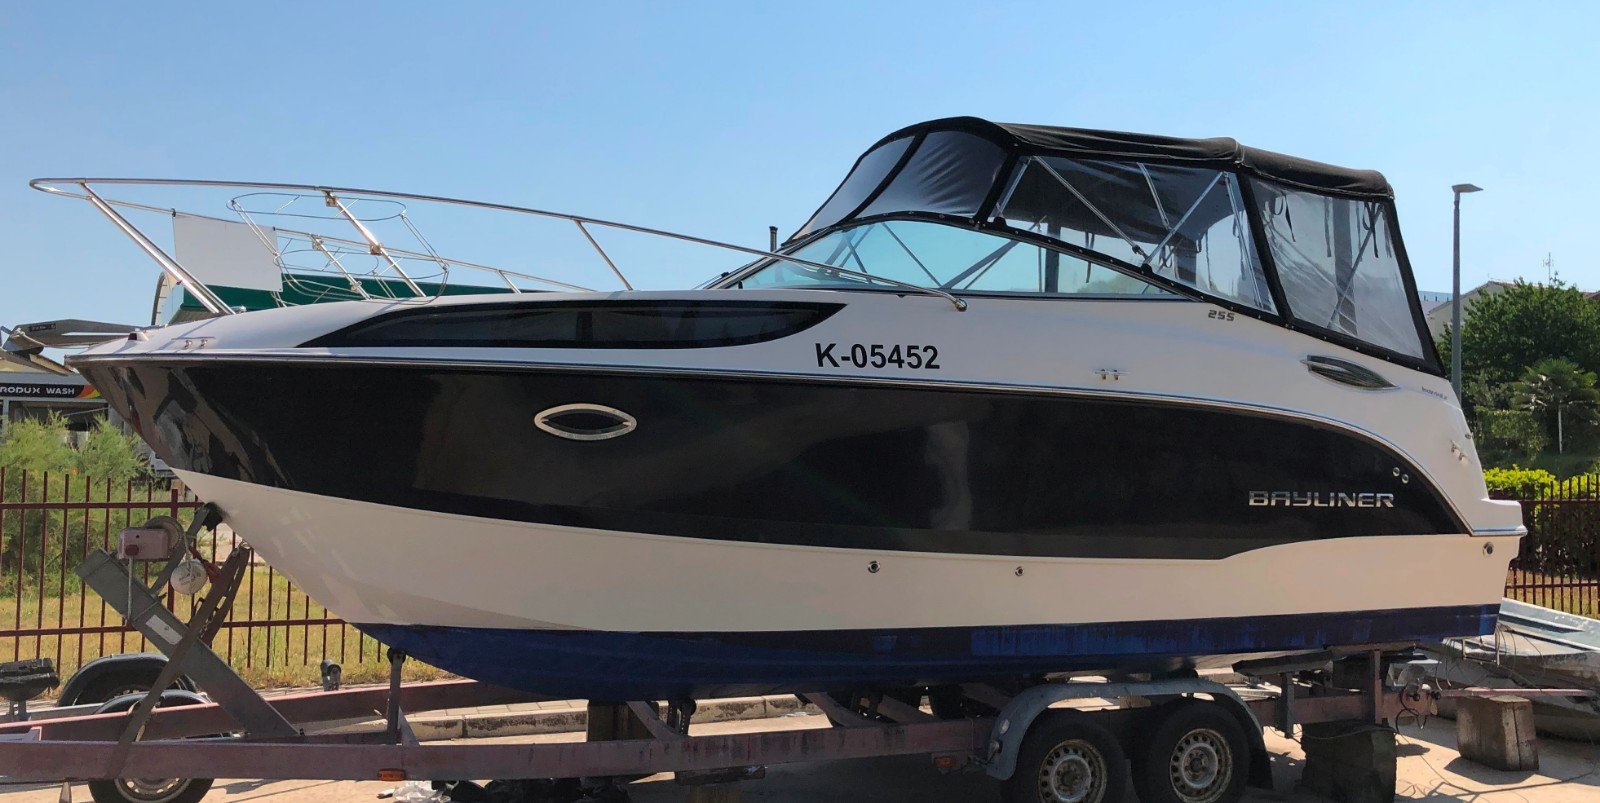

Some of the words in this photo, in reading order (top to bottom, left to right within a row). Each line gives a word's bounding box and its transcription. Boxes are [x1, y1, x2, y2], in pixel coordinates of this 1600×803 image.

[1208, 309, 1235, 321] 255
[815, 343, 940, 369] K-05452
[46, 387, 75, 395] WASH
[1248, 490, 1394, 508] BAYLINER
